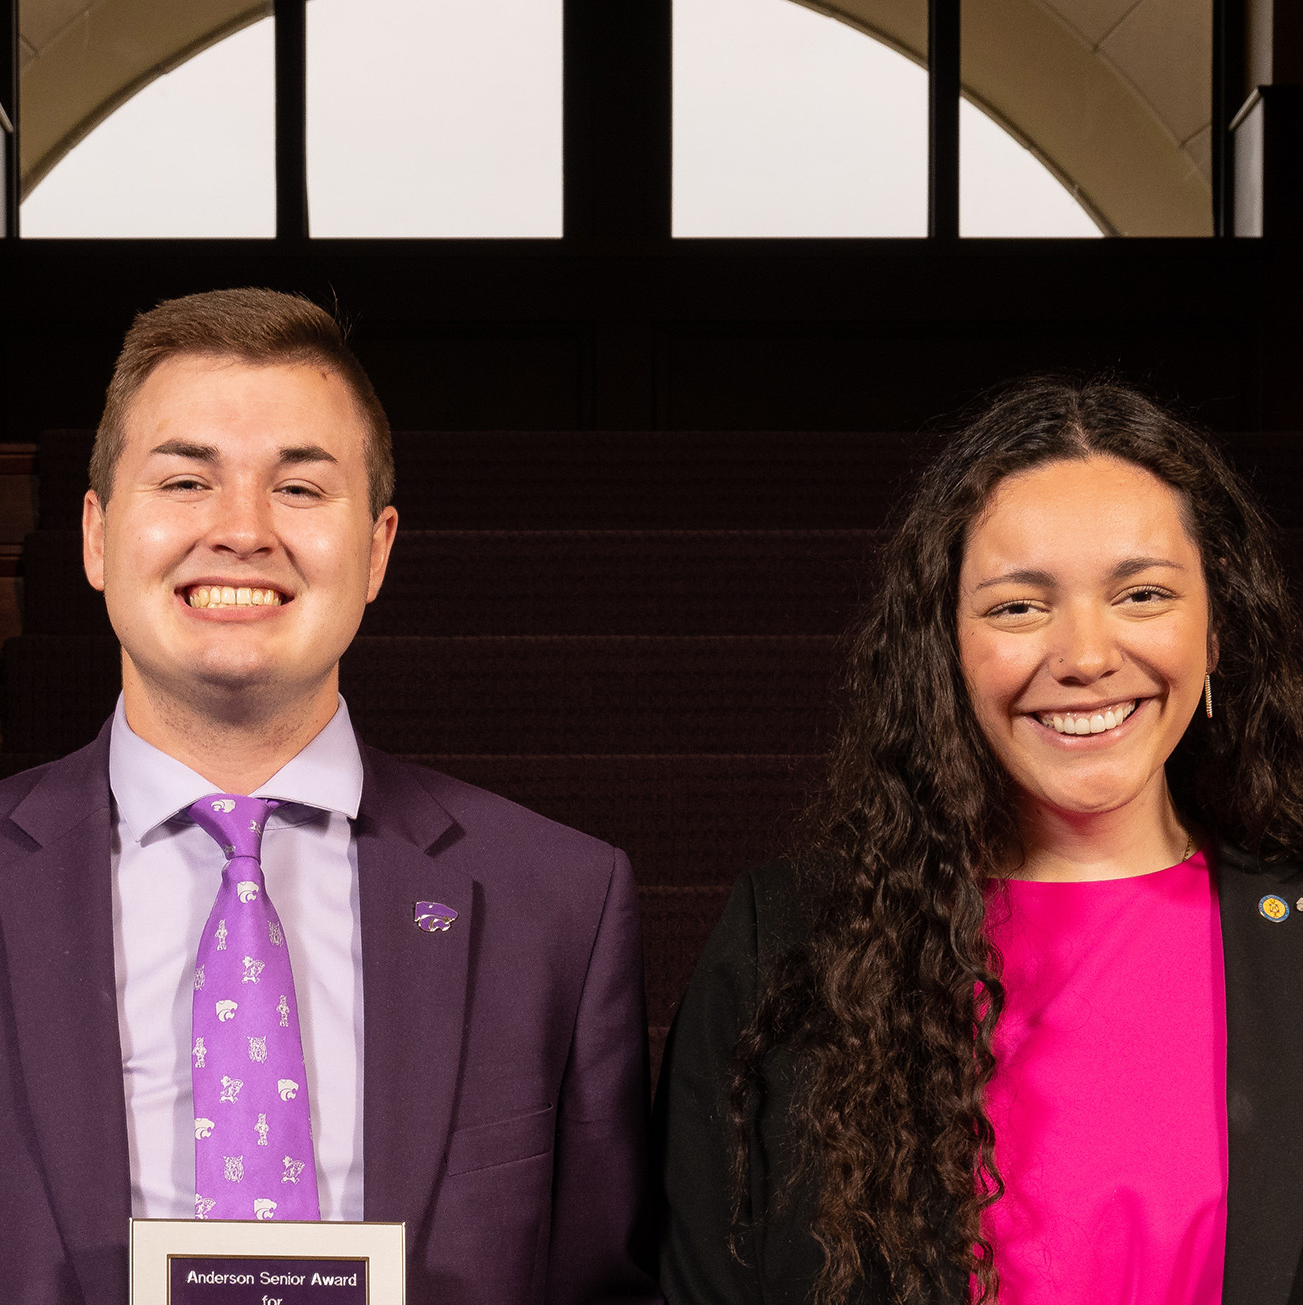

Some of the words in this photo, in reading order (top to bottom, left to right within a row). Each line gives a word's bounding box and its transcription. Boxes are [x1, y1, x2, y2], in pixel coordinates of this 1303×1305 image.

[186, 1270, 255, 1285] Anderson
[259, 1272, 306, 1286] Senior
[310, 1273, 357, 1287] Award
